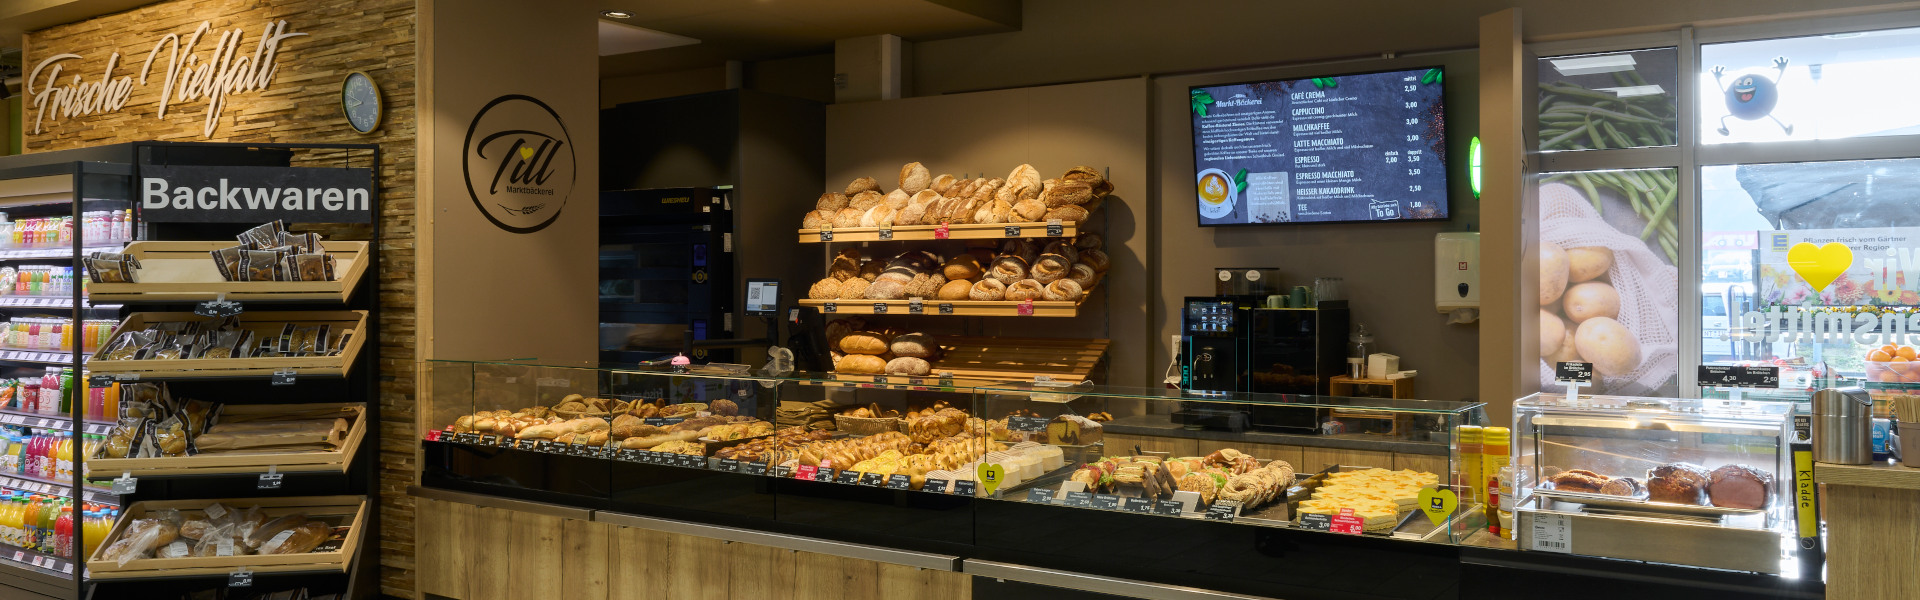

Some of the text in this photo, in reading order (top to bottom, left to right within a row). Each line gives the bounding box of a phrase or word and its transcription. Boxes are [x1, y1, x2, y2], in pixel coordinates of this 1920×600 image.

[28, 20, 309, 138] Frische Vielfalt
[1306, 90, 1325, 98] CREMA
[1292, 107, 1324, 116] CAPPUCCINO
[1293, 122, 1330, 132] MILCHKAFFEE
[1312, 138, 1344, 146] MACCHIATO
[477, 130, 564, 196] Till
[1295, 156, 1320, 164] ESPRESSO
[1322, 170, 1354, 178] MACCHIATO
[143, 178, 369, 210] Backwaren
[506, 186, 554, 196] Marktbäckerei
[1376, 208, 1394, 218] To Go
[1799, 470, 1811, 514] Kladde
